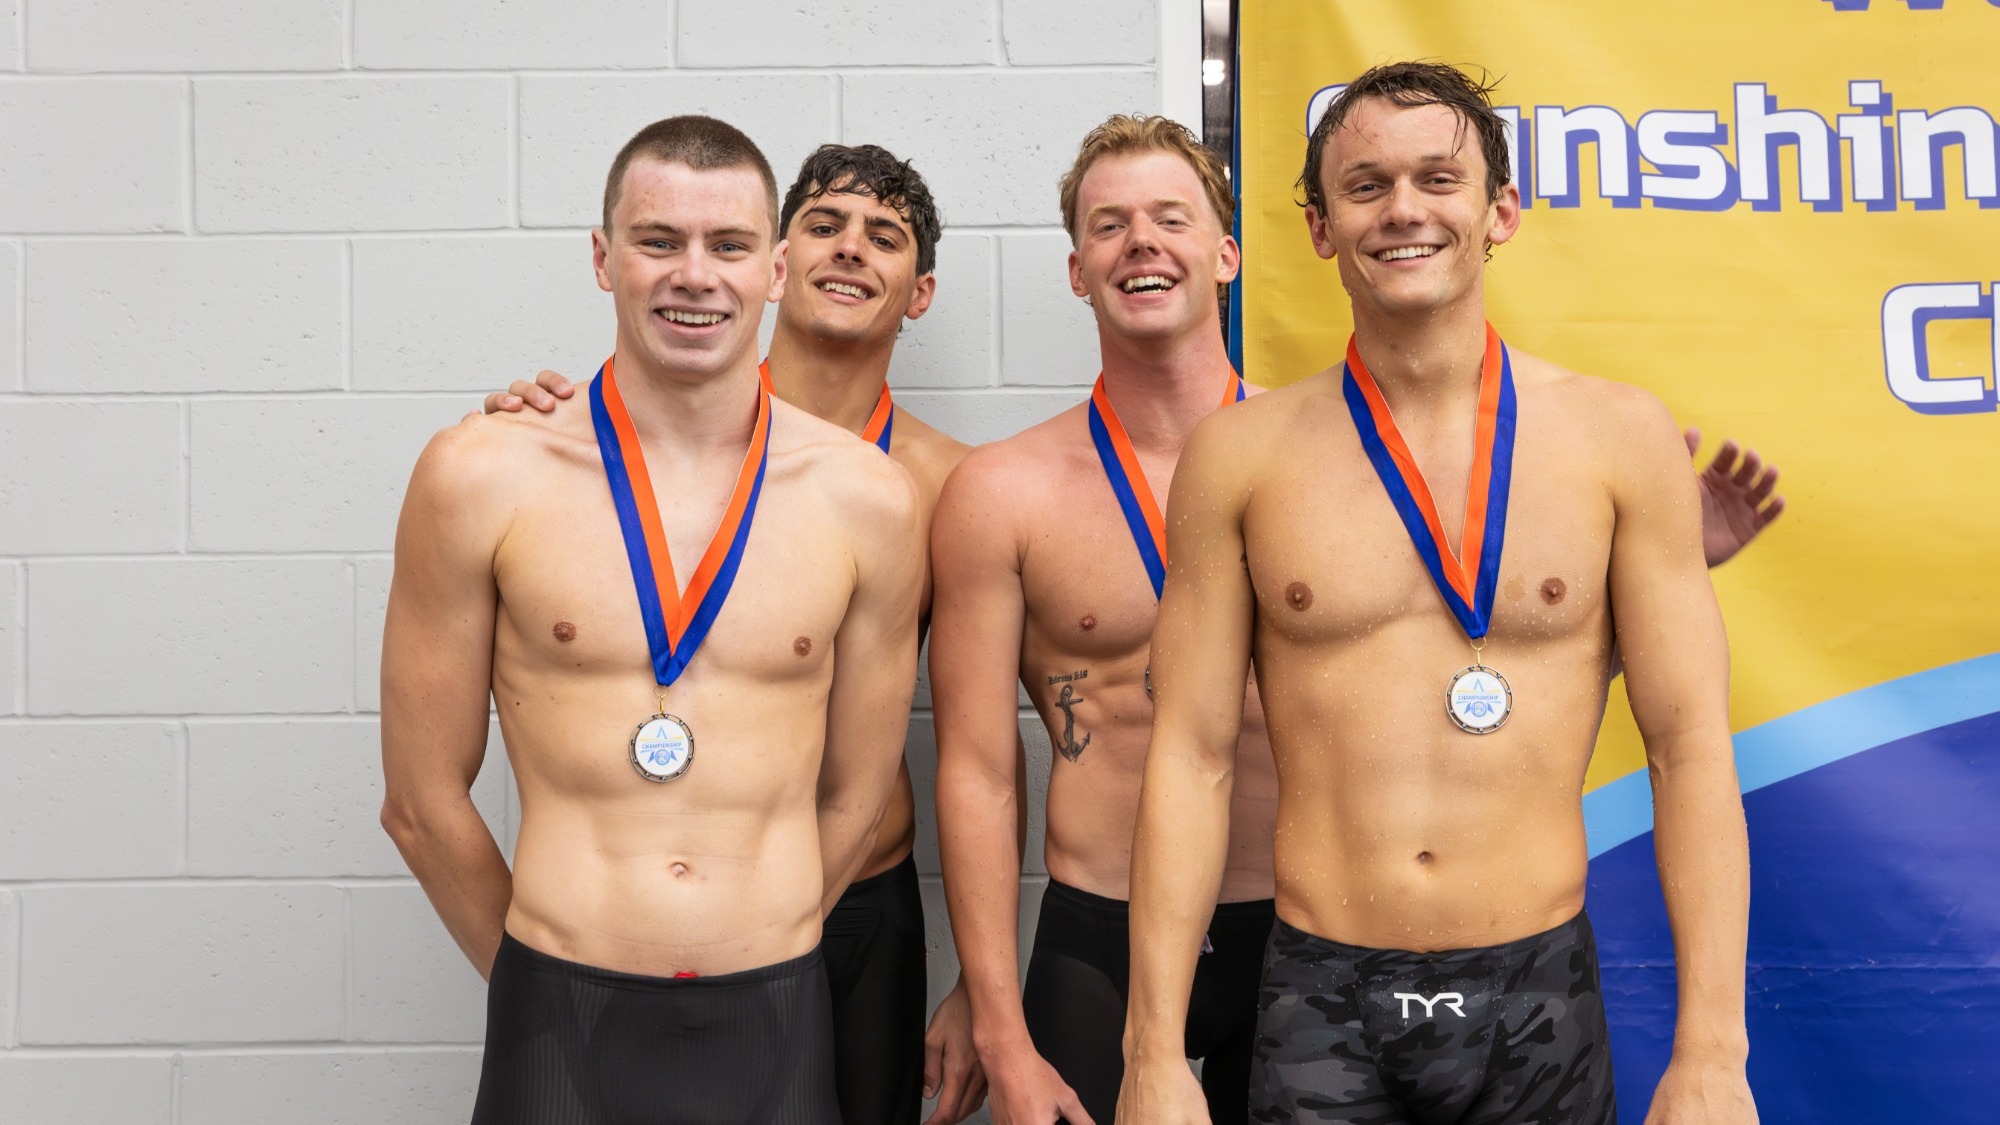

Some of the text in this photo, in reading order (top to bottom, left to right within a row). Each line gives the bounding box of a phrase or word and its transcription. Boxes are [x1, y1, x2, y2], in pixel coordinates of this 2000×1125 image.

[1307, 79, 2000, 212] nshin
[1881, 281, 2000, 415] C
[641, 741, 682, 750] CHAMPIONSHIP
[1394, 992, 1467, 1018] TYR
